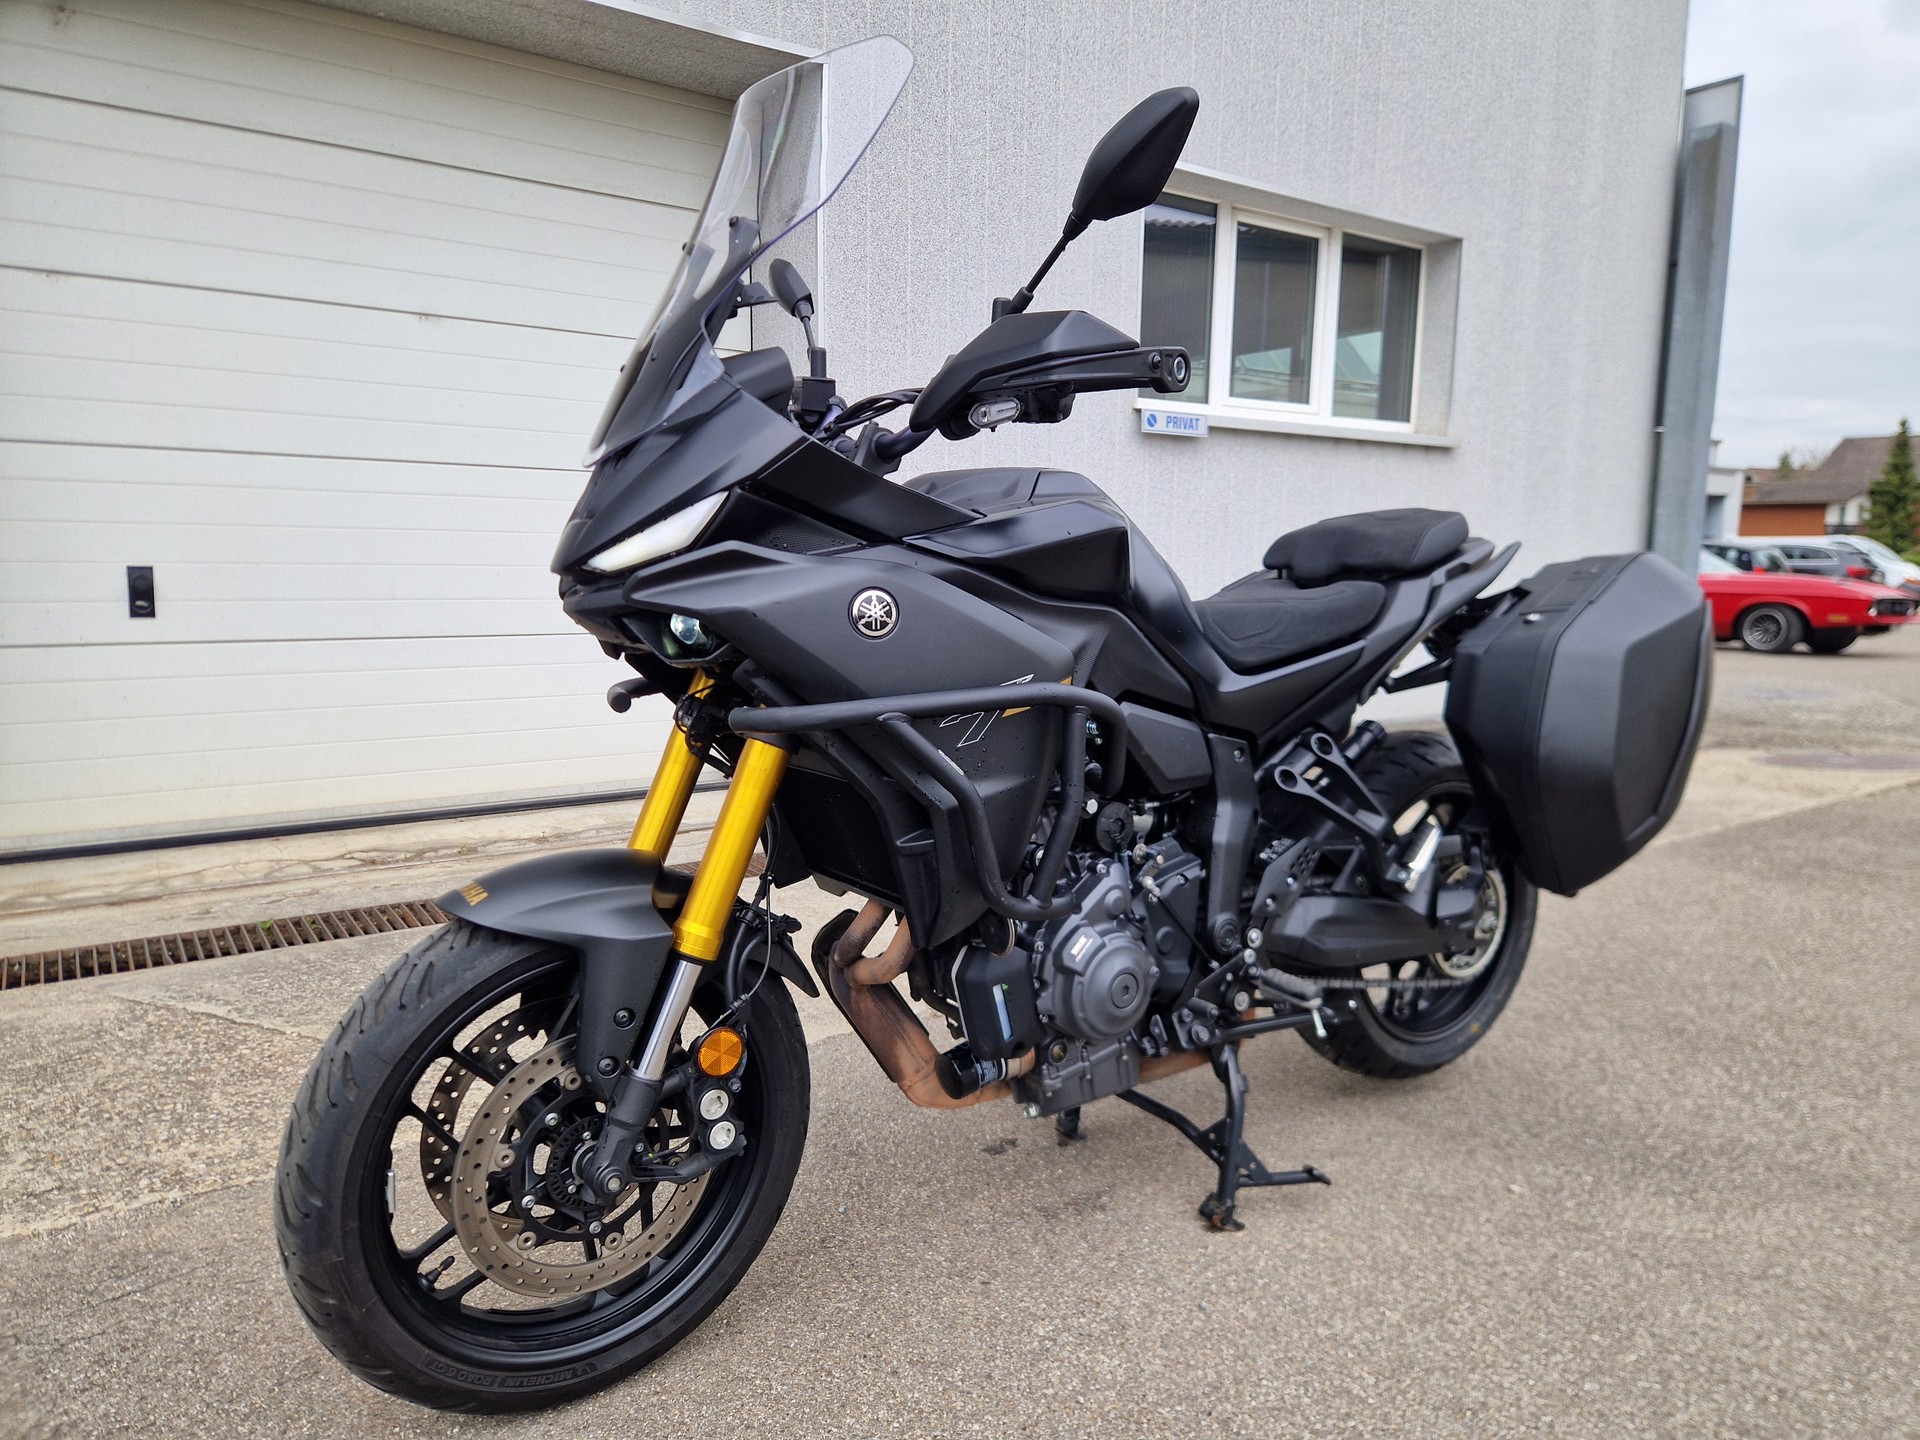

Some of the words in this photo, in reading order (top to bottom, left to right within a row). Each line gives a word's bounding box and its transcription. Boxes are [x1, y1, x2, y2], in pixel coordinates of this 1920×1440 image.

[1166, 415, 1200, 431] PRIVAT
[457, 1371, 493, 1385] ROAD
[504, 1369, 574, 1387] MICHELIN
